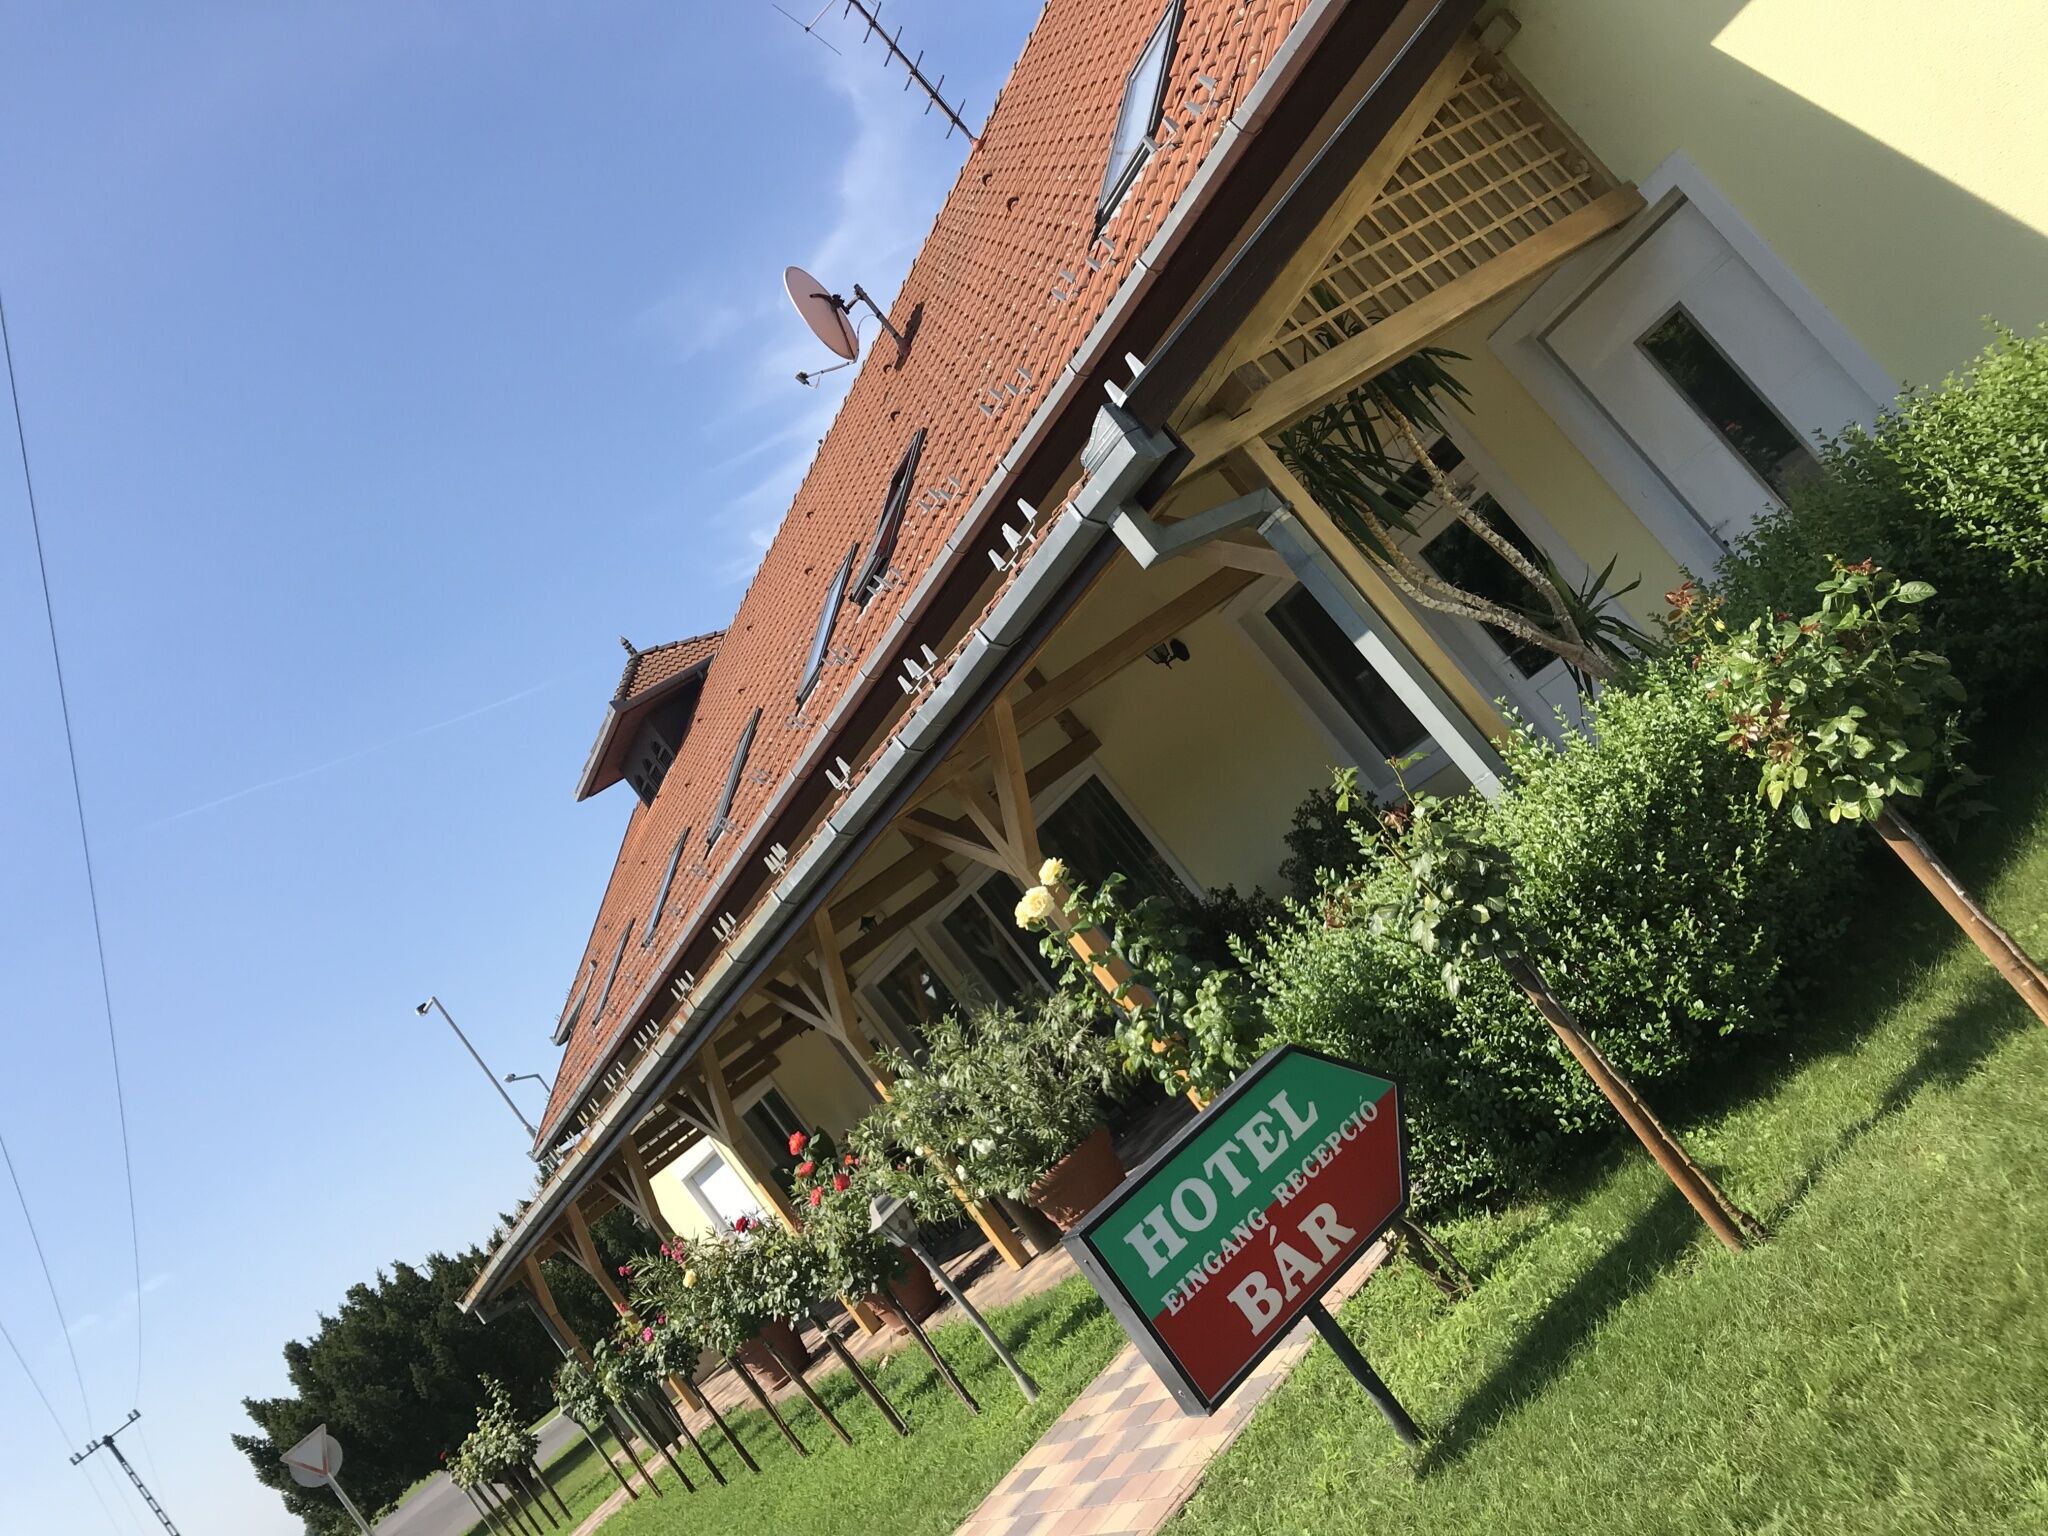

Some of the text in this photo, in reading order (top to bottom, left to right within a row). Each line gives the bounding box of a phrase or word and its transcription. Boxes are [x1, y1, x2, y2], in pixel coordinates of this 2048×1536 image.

[1123, 1089, 1319, 1279] HOTEL
[1160, 1095, 1378, 1317] EINGANG RECEPCIÓ
[1226, 1202, 1358, 1338] BÁR
